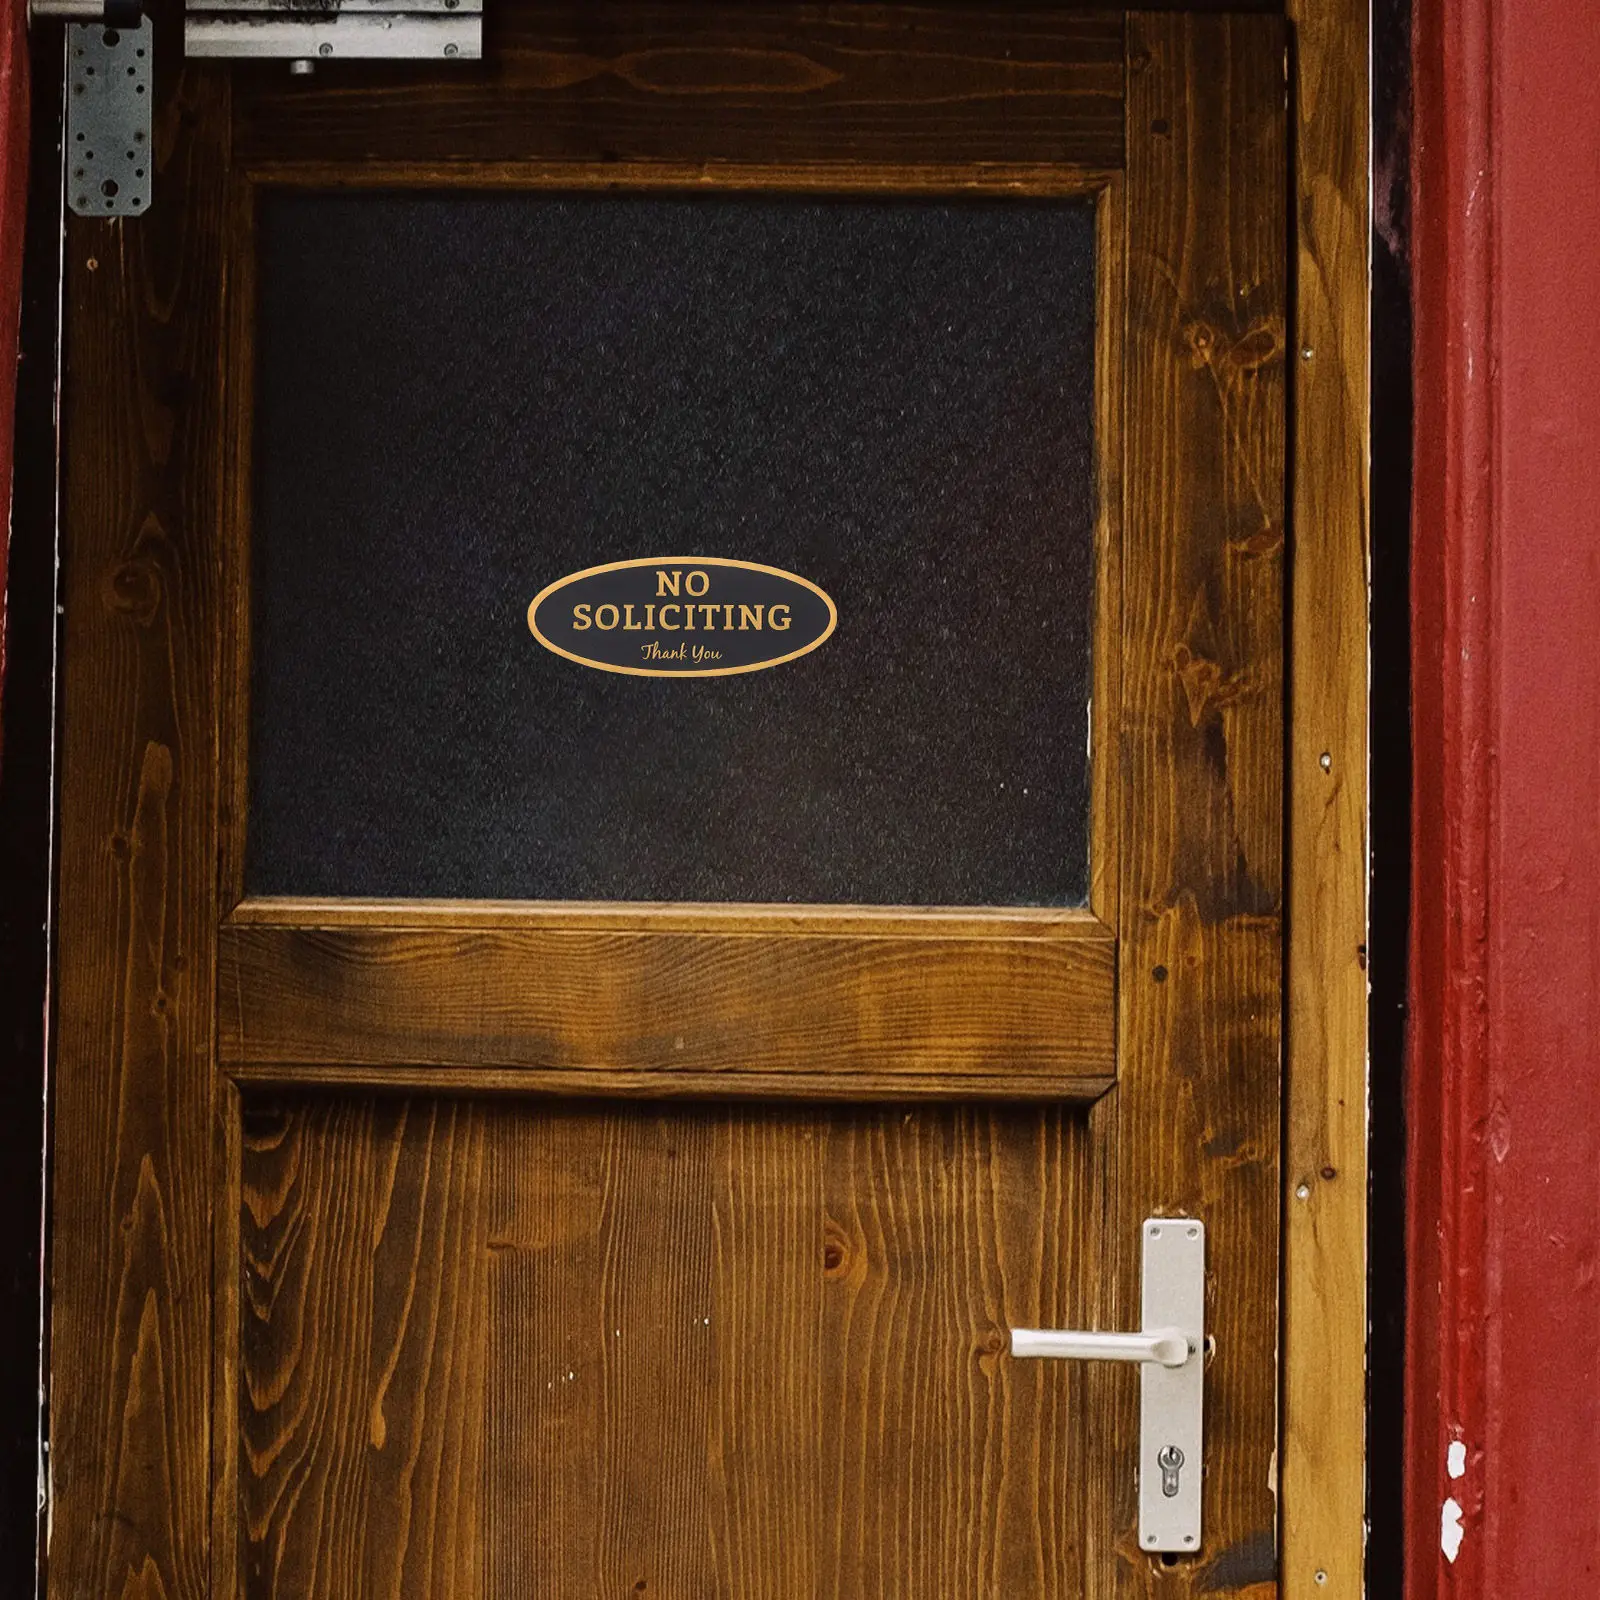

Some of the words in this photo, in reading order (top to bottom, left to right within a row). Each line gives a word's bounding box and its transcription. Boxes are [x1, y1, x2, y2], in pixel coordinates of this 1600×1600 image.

[655, 570, 710, 596] NO
[572, 604, 792, 631] SOLICITING
[641, 642, 687, 661] Thank
[692, 645, 722, 663] You
